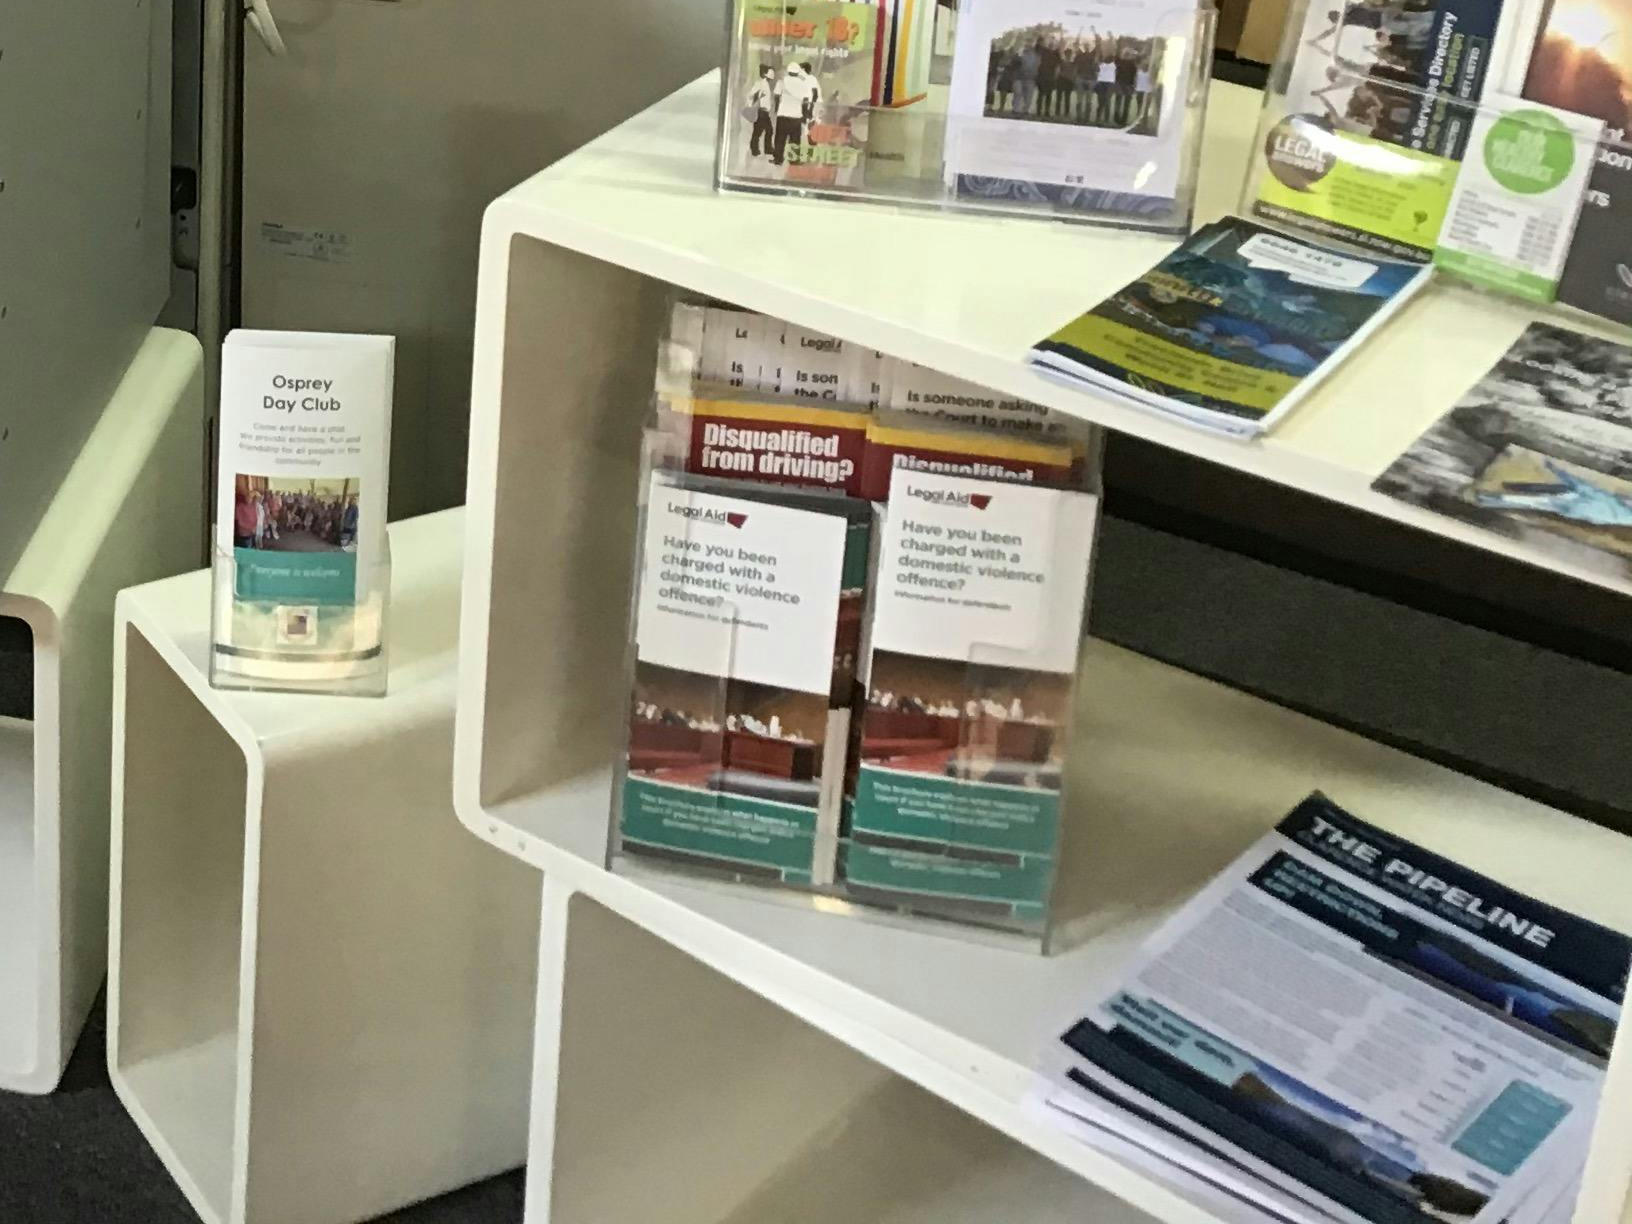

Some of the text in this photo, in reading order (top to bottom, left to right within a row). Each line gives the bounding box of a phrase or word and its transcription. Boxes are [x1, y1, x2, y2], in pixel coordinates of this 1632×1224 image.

[1428, 11, 1458, 76] Directory
[801, 337, 834, 351] Legal
[272, 375, 333, 393] Osprey
[264, 396, 341, 413] Day Club
[908, 390, 1049, 416] Is someone asking
[704, 423, 839, 458] Disqualified
[702, 446, 854, 483] from driving?
[907, 485, 968, 504] Legal Aid
[668, 502, 726, 522] Legal Aid
[902, 519, 1022, 546] Have you been
[664, 536, 777, 566] Have you been
[900, 538, 1020, 564] charged with a
[662, 553, 776, 583] charged with a
[896, 572, 966, 590] offence?
[898, 554, 1045, 584] domestic violence
[659, 586, 726, 608] offence?
[660, 570, 801, 605] domestic violence
[1312, 816, 1382, 864] THE
[1384, 858, 1556, 949] PIPELINE
